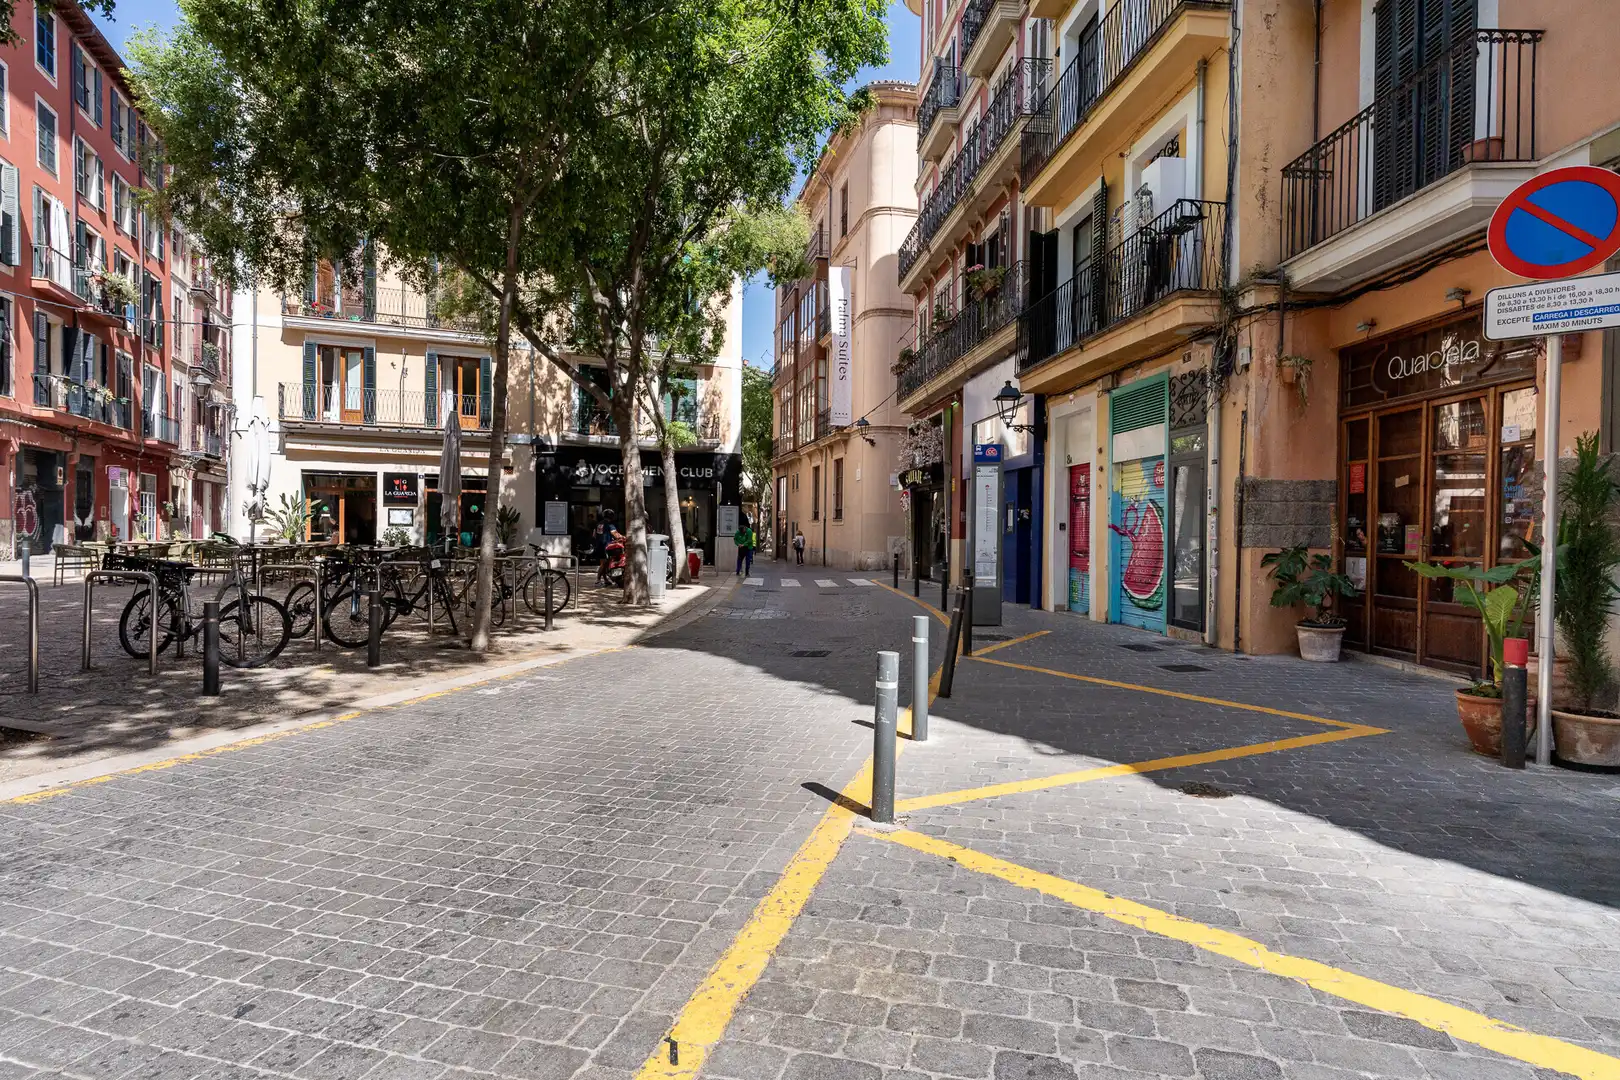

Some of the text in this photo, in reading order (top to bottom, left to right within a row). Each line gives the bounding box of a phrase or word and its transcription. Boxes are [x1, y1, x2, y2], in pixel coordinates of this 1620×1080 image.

[1497, 292, 1527, 301] DILLUNS
[1535, 285, 1576, 295] DIVENDRES
[1497, 304, 1535, 314] DISSABTES
[1497, 315, 1531, 326] EXCEPTE
[1574, 305, 1620, 316] DESCÀRREG
[1571, 317, 1603, 327] MINUTS
[837, 298, 849, 381] Palma Suites
[680, 467, 714, 478] CLUB
